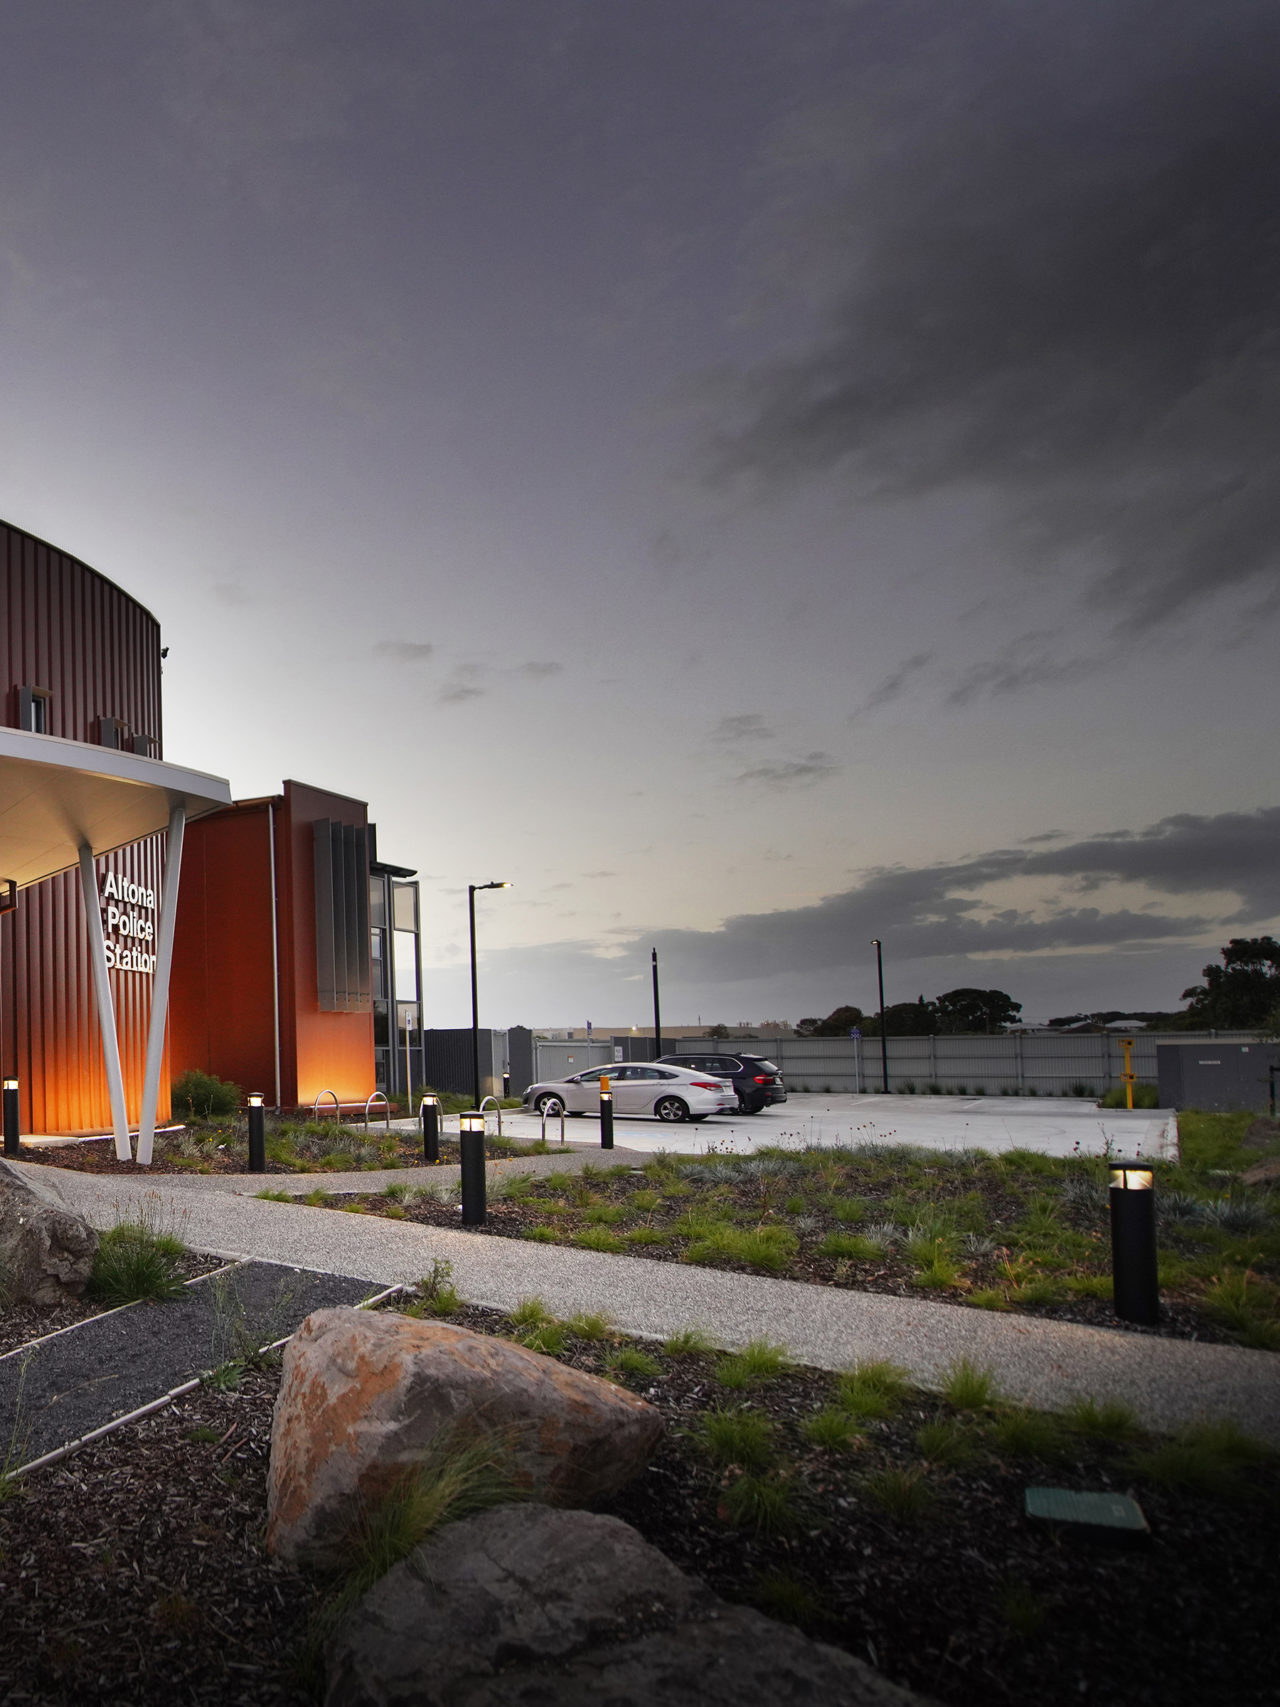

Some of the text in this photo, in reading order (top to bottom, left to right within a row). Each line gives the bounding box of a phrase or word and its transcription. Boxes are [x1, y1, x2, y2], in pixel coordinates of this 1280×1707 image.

[104, 871, 154, 909] Altona
[107, 906, 154, 941] Police
[103, 940, 157, 973] Station
